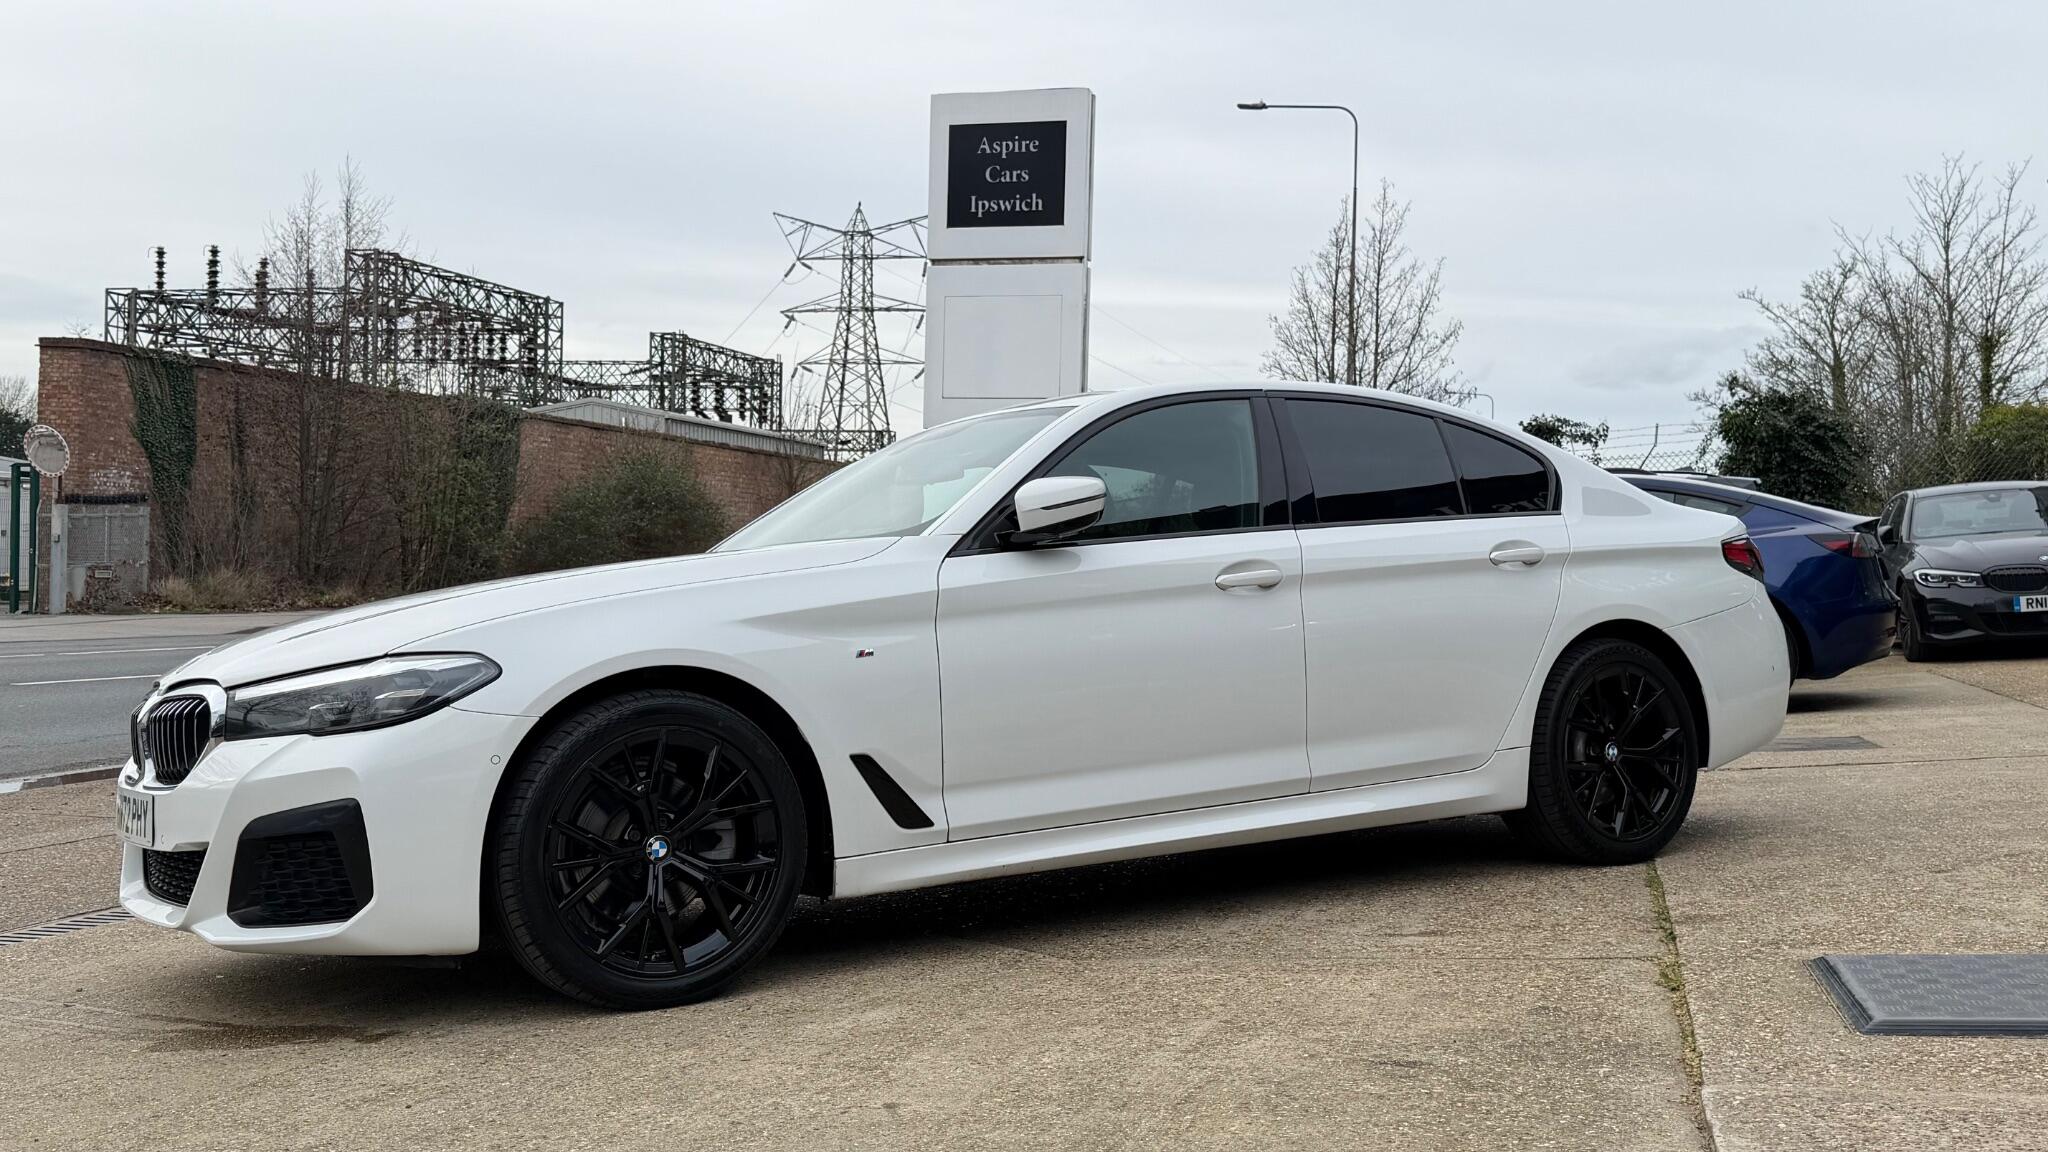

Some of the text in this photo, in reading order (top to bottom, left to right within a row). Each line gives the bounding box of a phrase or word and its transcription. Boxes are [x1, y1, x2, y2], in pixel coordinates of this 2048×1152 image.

[977, 135, 1040, 159] Aspire
[985, 165, 1030, 183] Cars
[970, 193, 1043, 217] Ipswich
